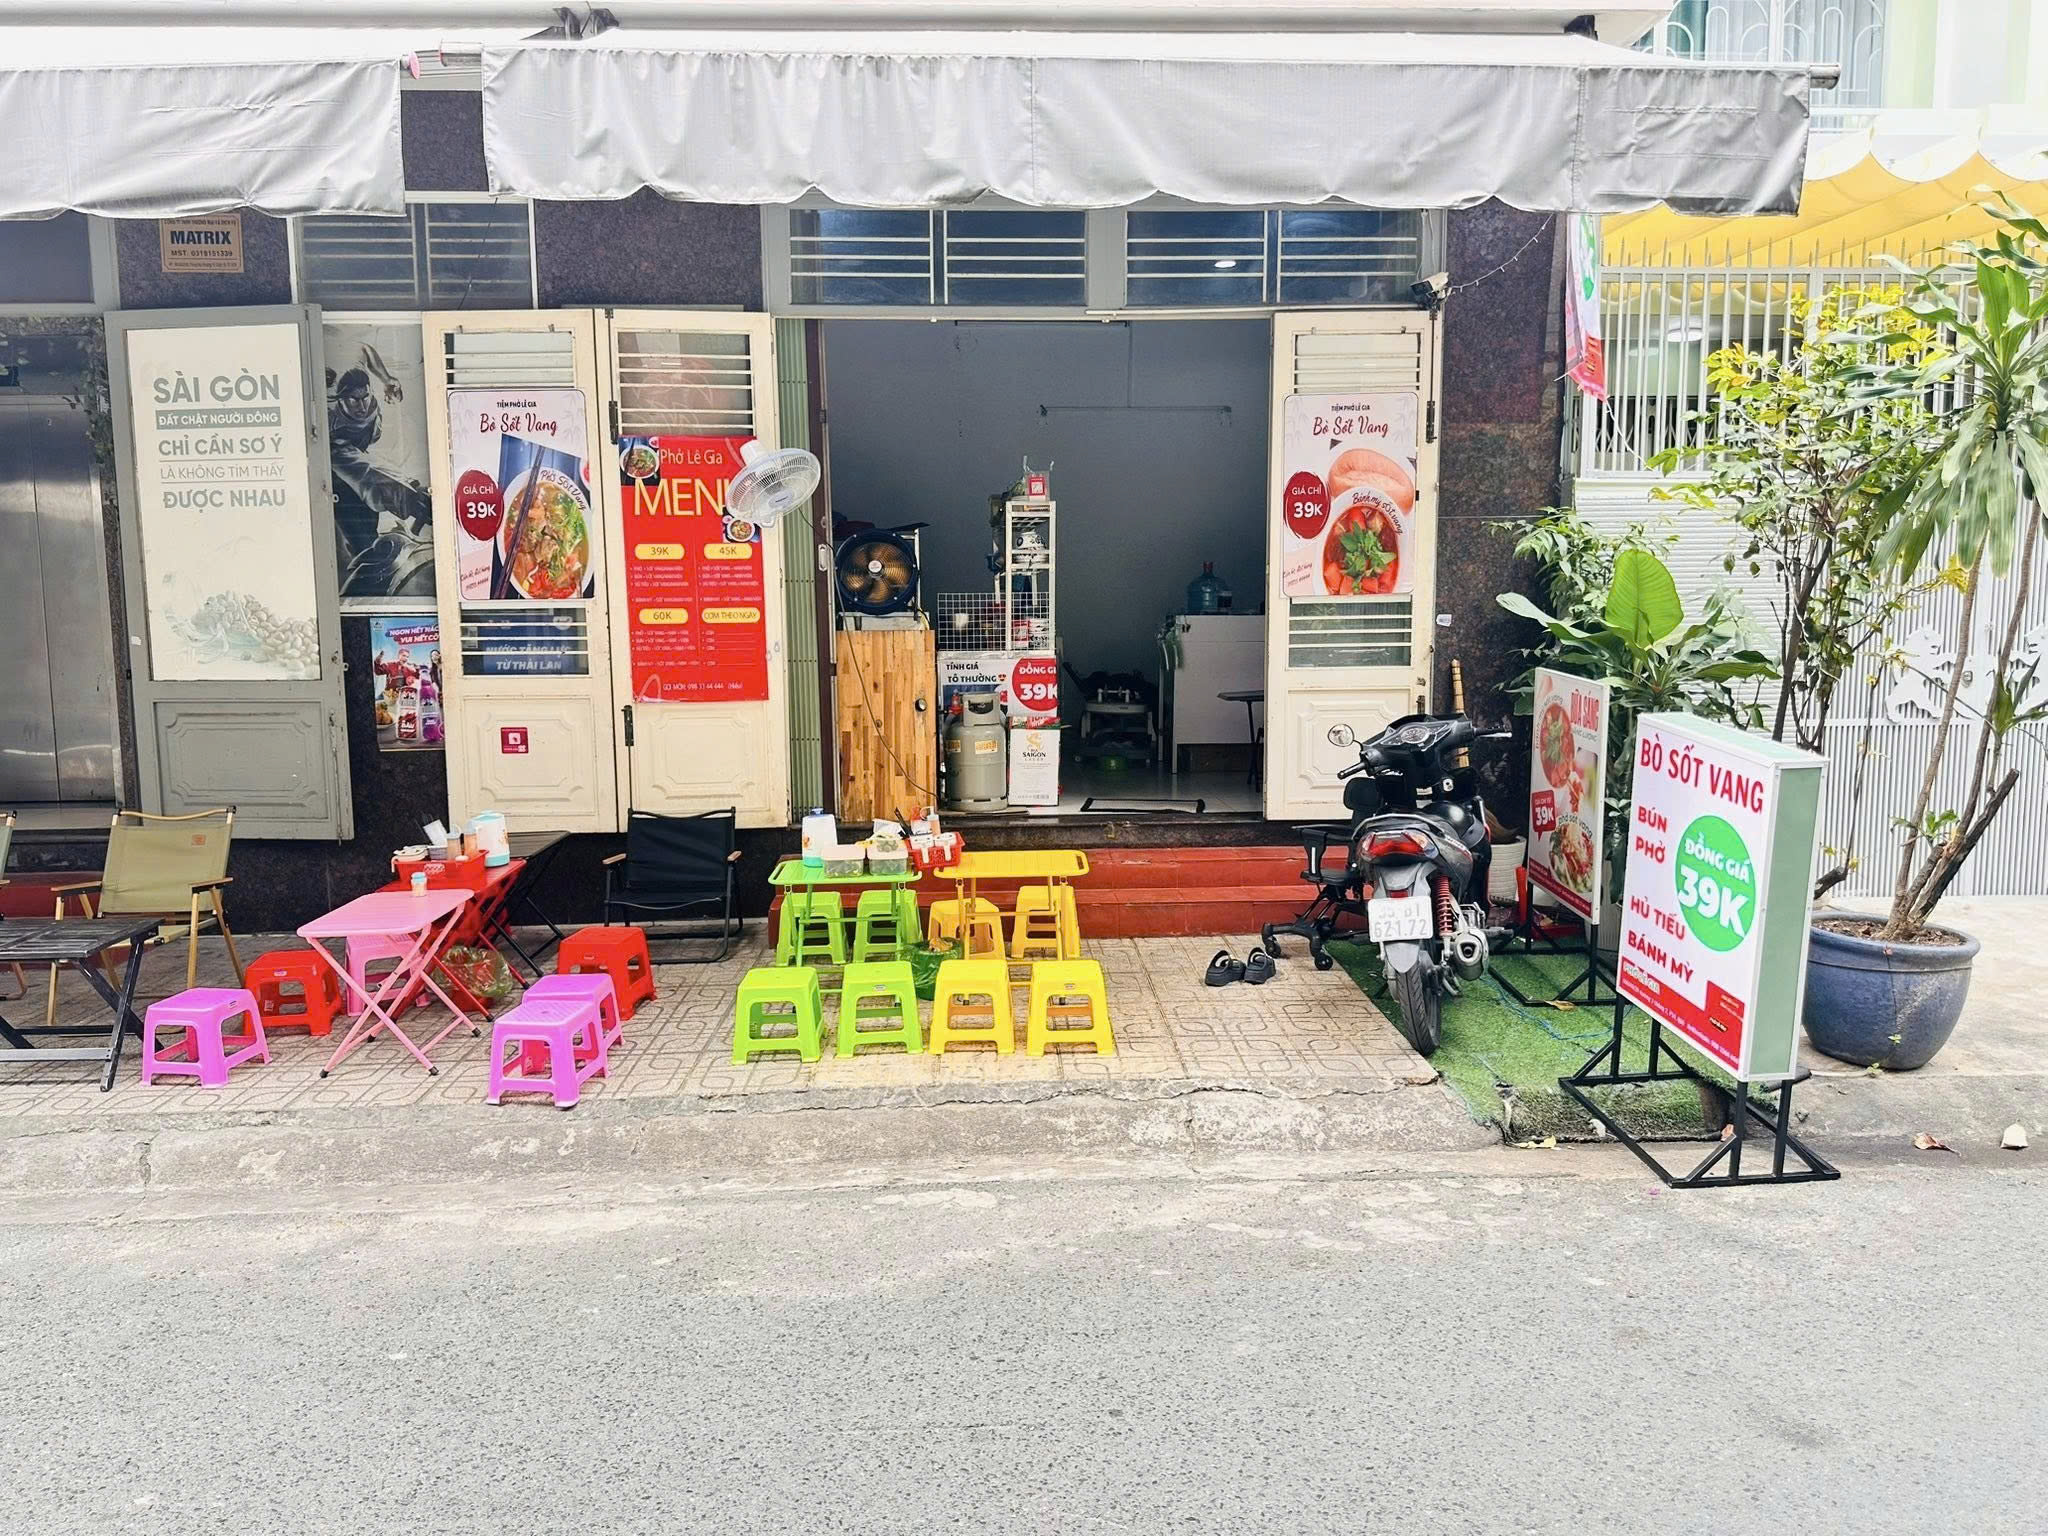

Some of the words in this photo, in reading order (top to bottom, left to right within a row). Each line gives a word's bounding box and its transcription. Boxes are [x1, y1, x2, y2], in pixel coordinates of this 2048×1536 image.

[170, 231, 232, 244] MATRIX
[153, 371, 201, 404] SÀI
[209, 368, 280, 402] GÒN
[159, 413, 179, 425] ĐẤT
[181, 413, 209, 427] CHẬT
[210, 412, 244, 424] NGƯỜI
[246, 411, 279, 423] ĐÔNG
[480, 413, 496, 433] Bò
[501, 412, 521, 432] Sốt
[525, 412, 557, 436] Vang
[1313, 416, 1329, 436] Bò
[1333, 415, 1353, 435] Sốt
[1358, 415, 1388, 438] Vang
[158, 434, 190, 456] CHỈ
[195, 433, 234, 455] CẦN
[240, 436, 266, 454] SƠ
[270, 433, 283, 453] Ý
[660, 449, 684, 465] Phở
[687, 449, 701, 465] Lê
[703, 449, 723, 465] Gia
[160, 465, 176, 480] LÀ
[179, 464, 225, 480] KHÔNG
[228, 463, 249, 478] TÌM
[252, 461, 285, 476] THẤY
[463, 484, 477, 495] GIÁ
[479, 483, 494, 495] CHỈ
[634, 478, 729, 516] MEN
[1291, 486, 1306, 496] GIÁ
[1308, 484, 1322, 495] CHỈ
[163, 489, 224, 514] ĐƯỢC
[230, 489, 286, 508] NHAU
[466, 501, 497, 519] 39K
[1293, 501, 1323, 519] 39K
[650, 546, 669, 556] 39K
[719, 546, 737, 555] 45K
[653, 611, 672, 620] 60K
[496, 659, 511, 670] TỪ
[540, 661, 561, 670] LAN
[946, 661, 965, 670] TÍNH
[965, 661, 979, 670] GIÁ
[1019, 661, 1047, 674] ĐỒNG
[948, 673, 959, 683] TÔ
[960, 673, 997, 682] THƯỜNG
[1020, 683, 1057, 700] 39K
[1640, 733, 1663, 772] BÒ
[1668, 744, 1704, 788] SỐT
[1709, 763, 1764, 815] VANG
[1535, 806, 1554, 826] 39K
[1638, 805, 1668, 833] BÚN
[1635, 836, 1666, 864] PHỞ
[1685, 832, 1725, 871] ĐỒNG
[1725, 858, 1750, 885] GIÁ
[1678, 864, 1749, 939] 39K
[1654, 908, 1685, 940] TIẾU
[1628, 930, 1667, 968] BÁNH
